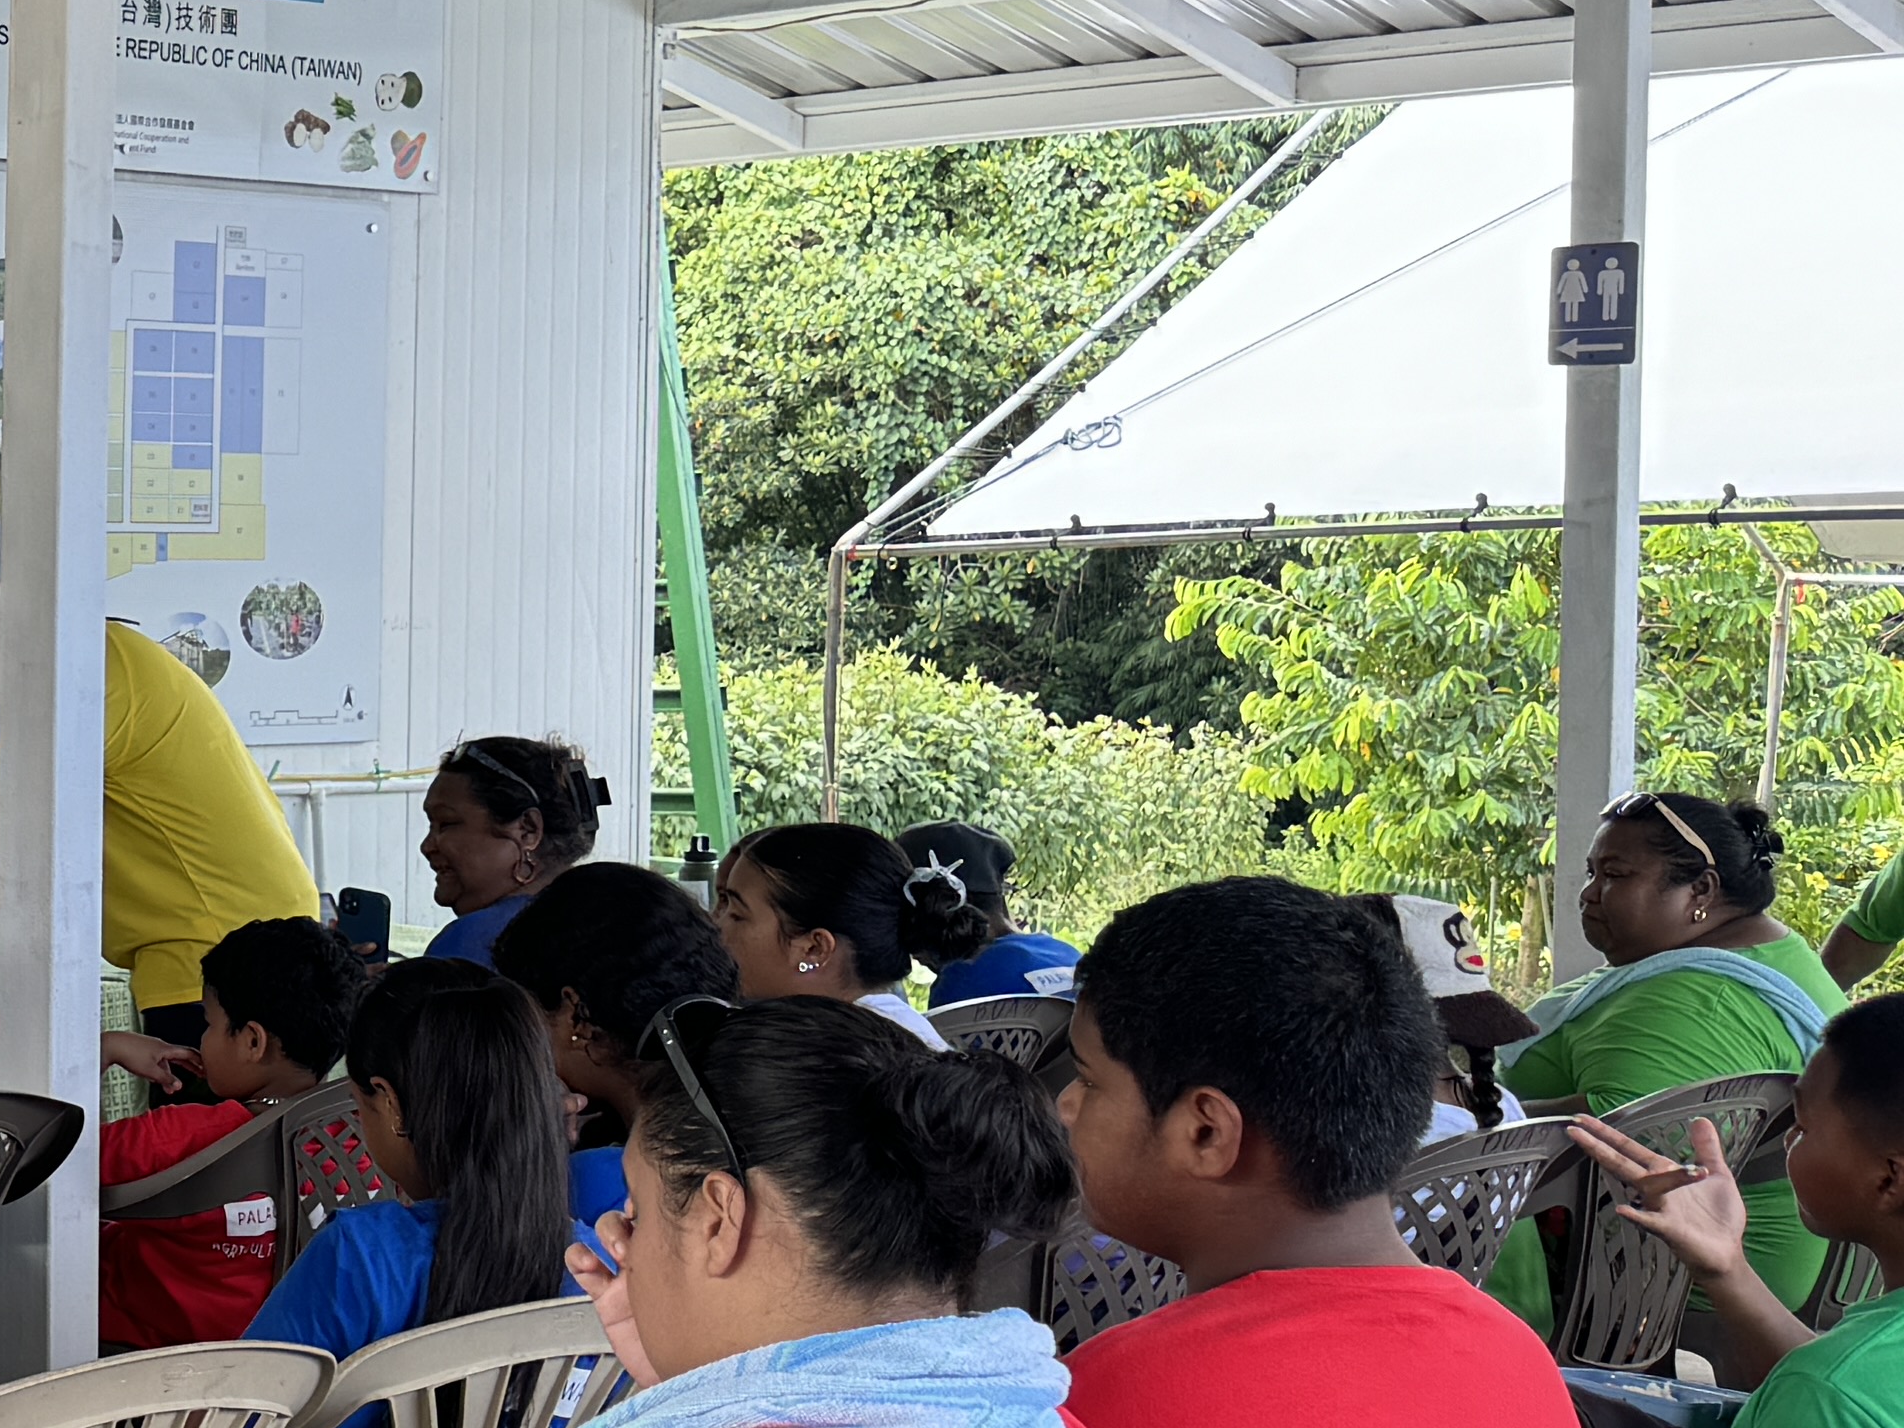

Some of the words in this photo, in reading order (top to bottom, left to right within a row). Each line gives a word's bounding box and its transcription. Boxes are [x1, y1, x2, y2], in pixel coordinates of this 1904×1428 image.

[125, 38, 208, 66] REPUBLIC
[212, 48, 234, 69] OF
[238, 50, 287, 75] CHINA
[291, 55, 363, 87] (TAIWAN)
[237, 1206, 273, 1226] PALA
